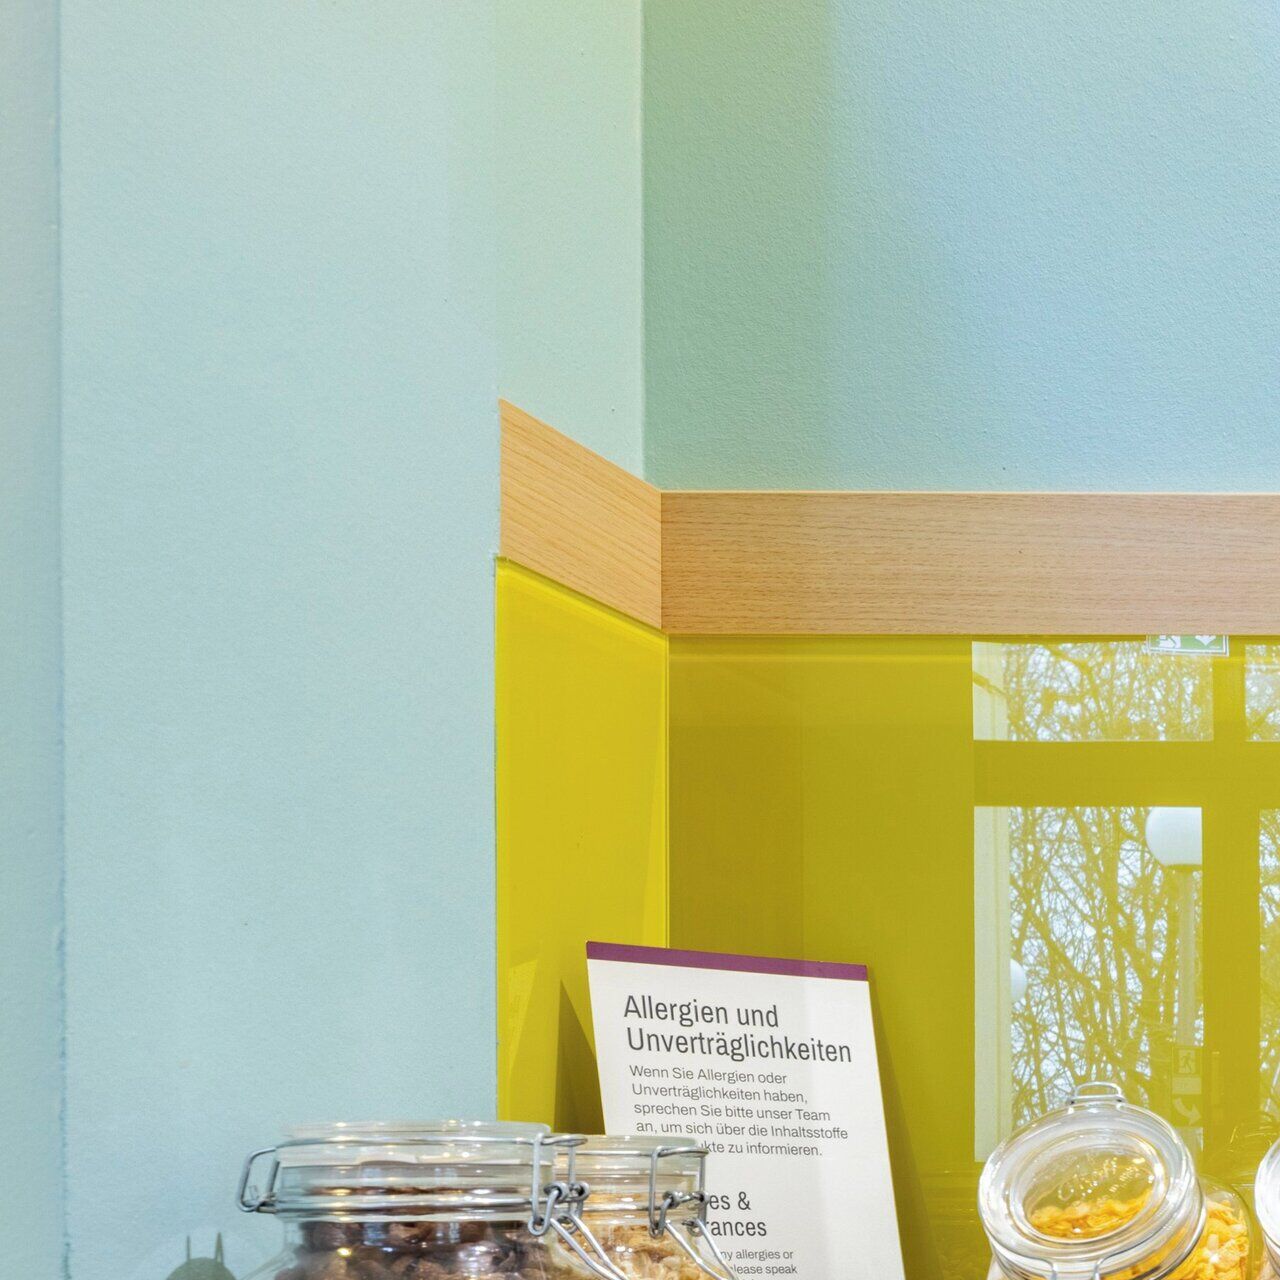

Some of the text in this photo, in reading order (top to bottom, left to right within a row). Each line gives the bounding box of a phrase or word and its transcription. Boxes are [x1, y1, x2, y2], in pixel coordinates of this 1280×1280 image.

[624, 995, 779, 1027] Allergien und
[627, 1026, 852, 1063] Unverträglichkeiten
[629, 1064, 787, 1085] Wenn Sie Allergien oder
[631, 1083, 808, 1105] Unverträglichkeiten haben,
[634, 1102, 831, 1121] sprechen Sie bitte unser Team
[636, 1121, 848, 1140] an, um sich über die Inhaltsstoffe
[728, 1143, 744, 1154] zu
[746, 1141, 823, 1156] informieren.
[737, 1191, 751, 1211] &
[735, 1250, 781, 1261] allergies
[782, 1251, 794, 1259] or
[730, 1264, 798, 1277] lease speak
